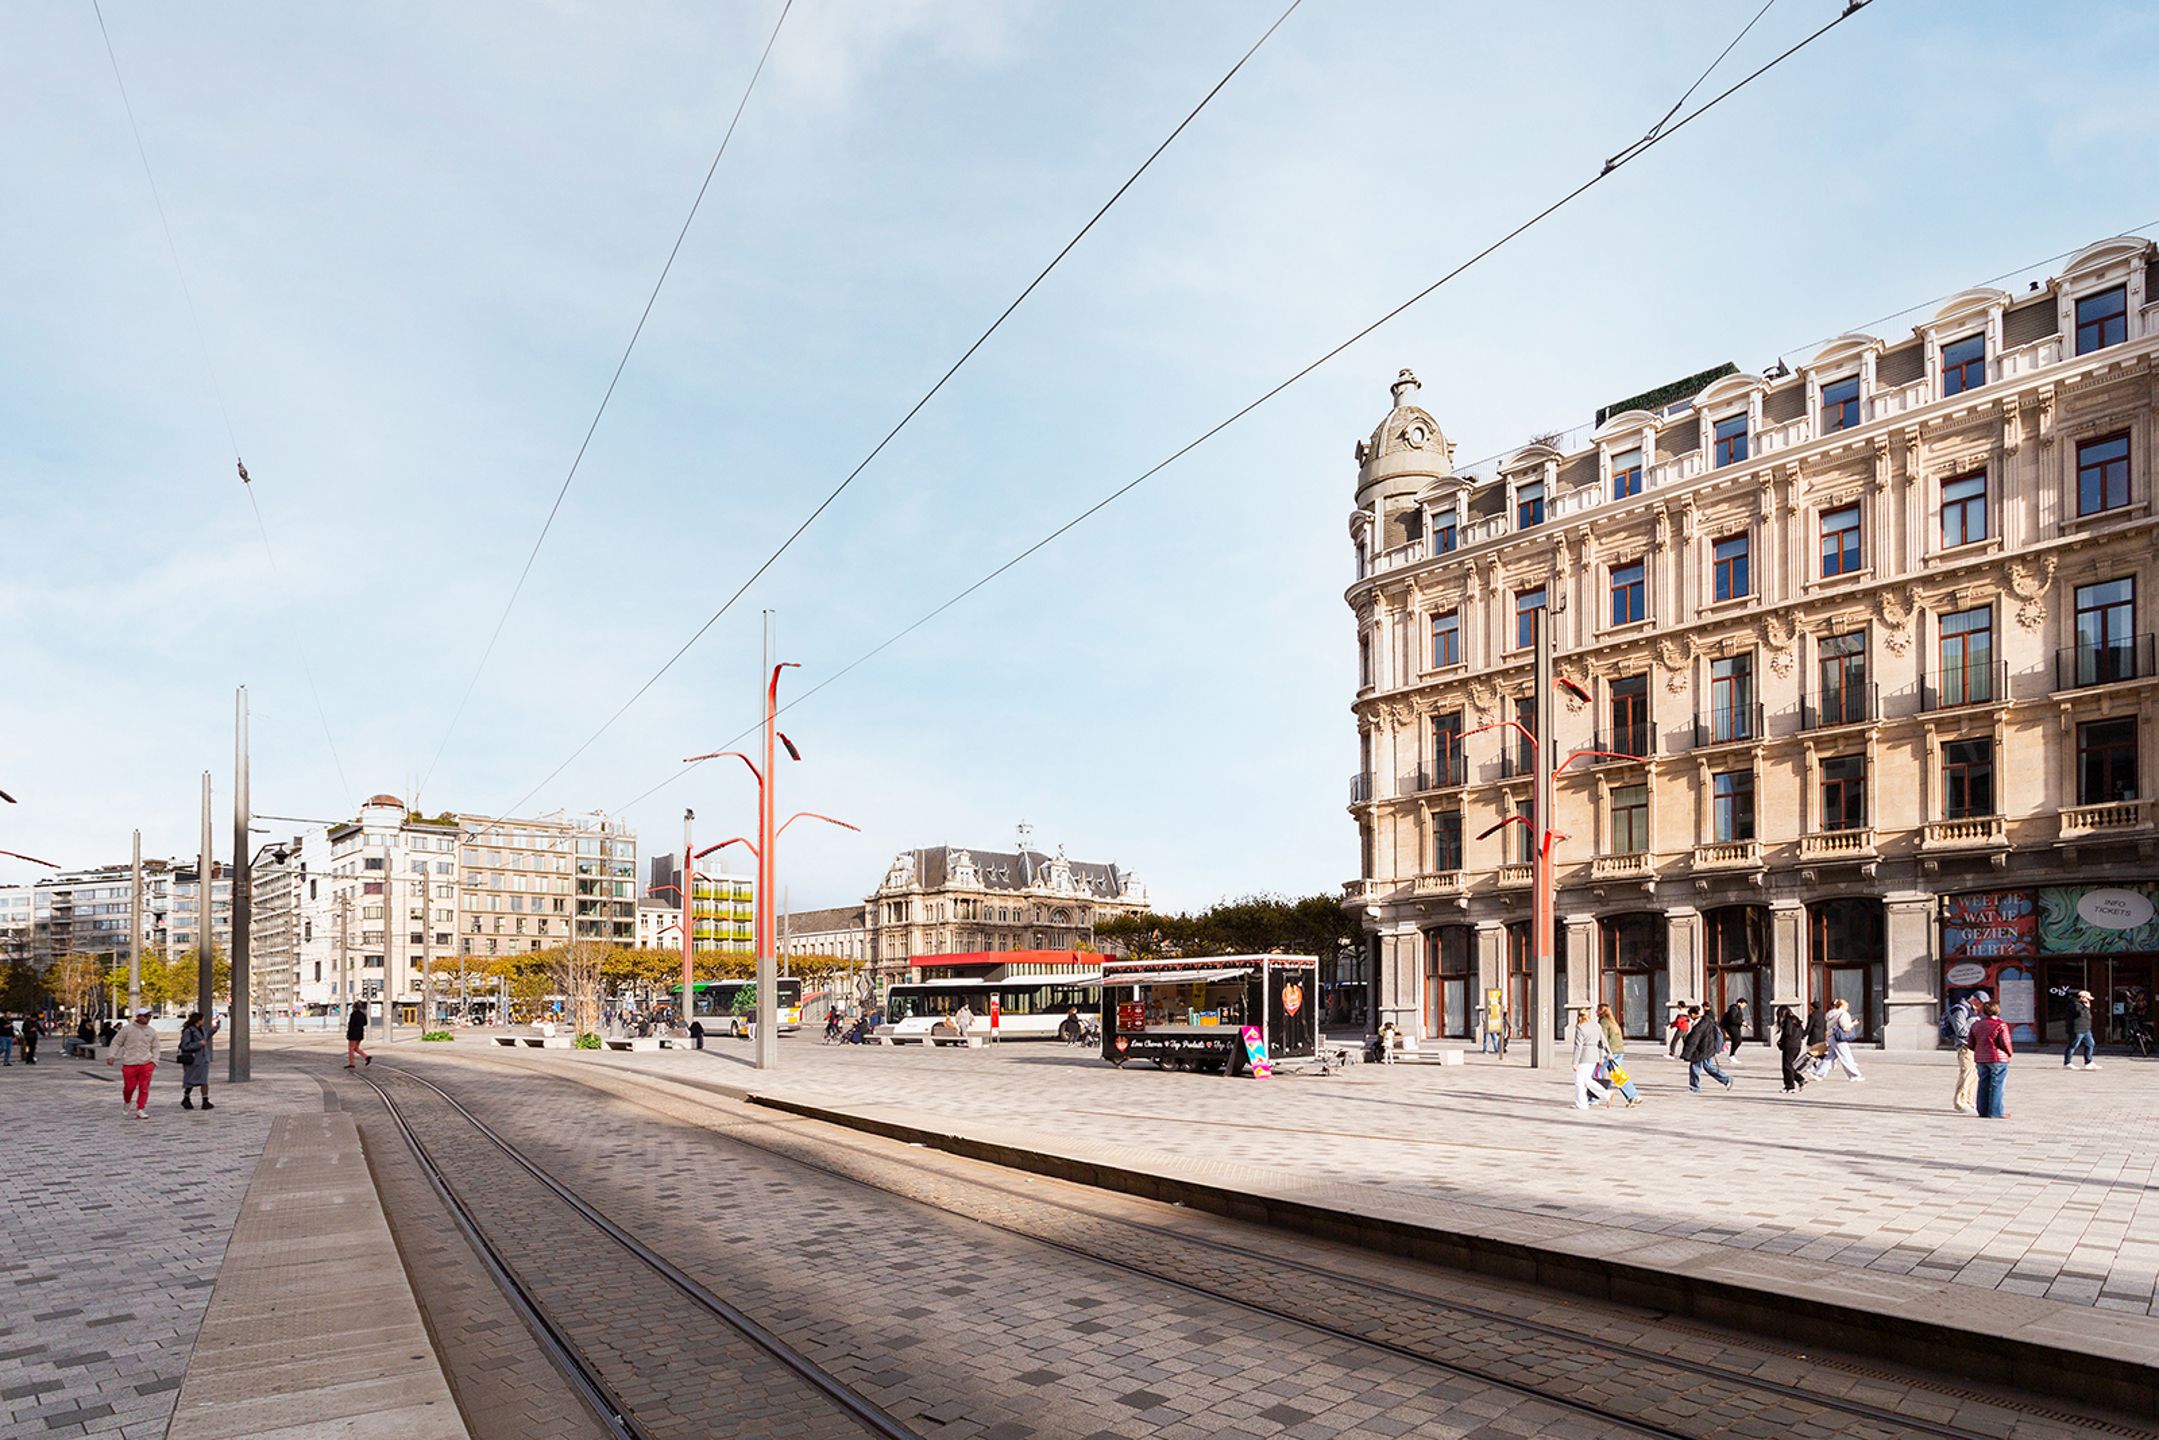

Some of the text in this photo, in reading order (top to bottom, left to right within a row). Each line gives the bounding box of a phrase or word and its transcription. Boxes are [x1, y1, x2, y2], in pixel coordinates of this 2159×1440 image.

[1960, 894, 2023, 906] WEET JE
[2104, 900, 2126, 908] INFO
[1964, 911, 2017, 922] WAT JE
[2094, 905, 2132, 917] TICKETS
[1961, 928, 2018, 940] GEZIEN
[1966, 944, 2015, 956] HEBT?
